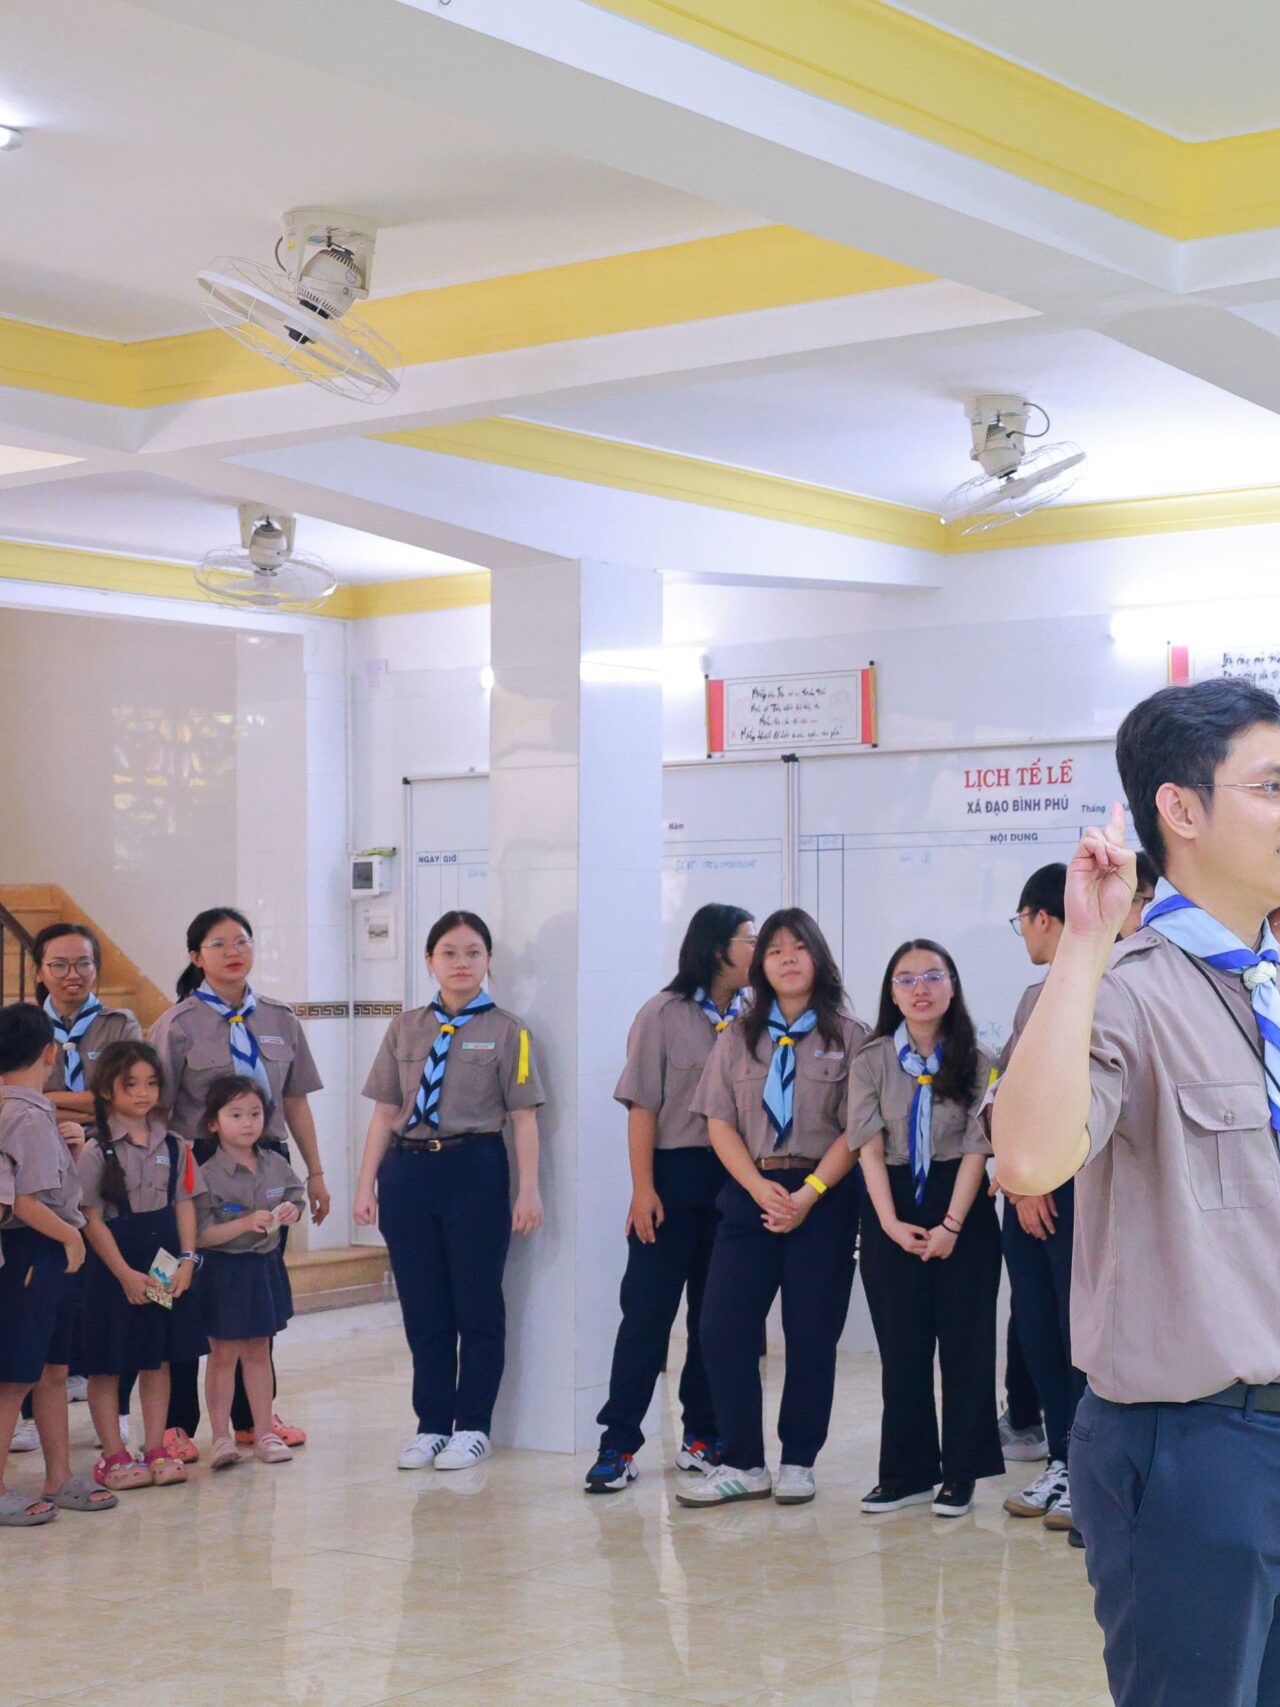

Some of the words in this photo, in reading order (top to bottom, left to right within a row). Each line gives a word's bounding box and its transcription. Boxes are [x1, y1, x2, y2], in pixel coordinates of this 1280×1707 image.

[964, 768, 1010, 791] LỊCH
[1017, 757, 1042, 786] TẾ
[985, 800, 1009, 817] ĐẠO
[1013, 796, 1041, 812] BÌNH
[1045, 794, 1069, 811] PHÚ
[990, 831, 1009, 844] NỘI
[1010, 831, 1039, 842] DUNG
